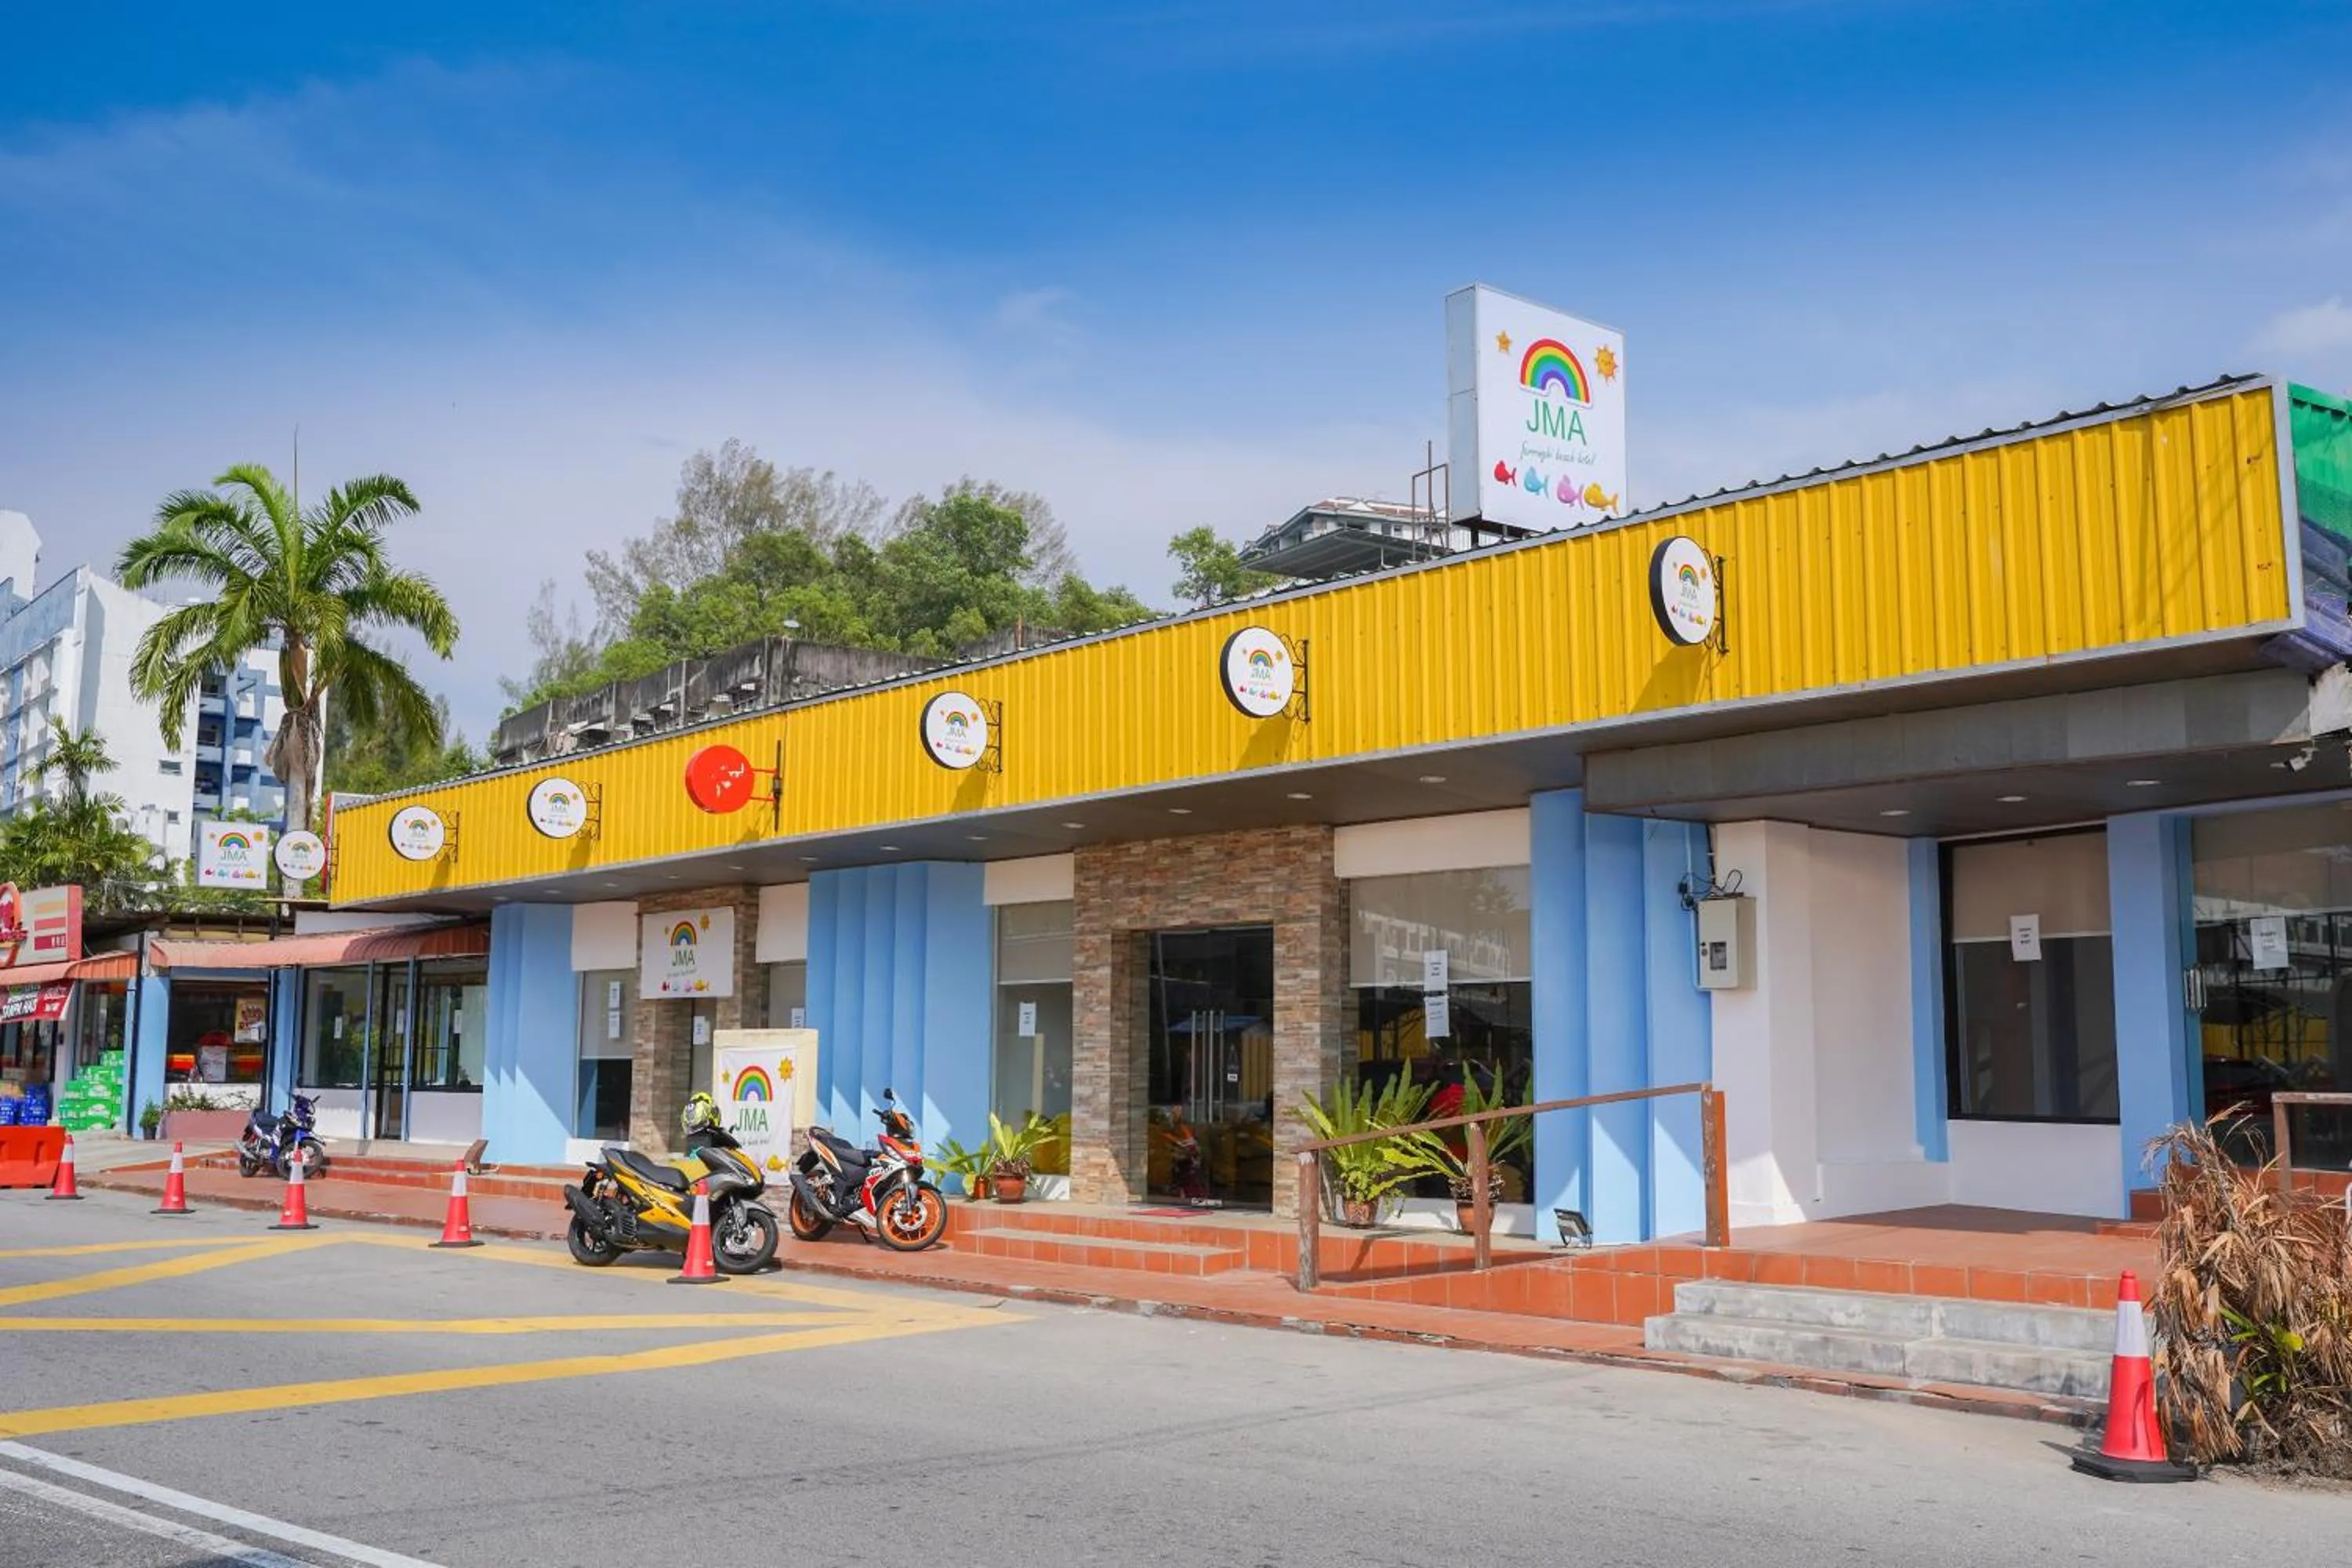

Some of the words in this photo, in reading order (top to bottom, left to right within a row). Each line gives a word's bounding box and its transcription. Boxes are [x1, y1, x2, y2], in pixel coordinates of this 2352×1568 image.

[1526, 398, 1587, 446] JMA
[220, 849, 248, 862] JMA
[671, 949, 695, 967] JMA
[733, 1107, 769, 1132] JMA
